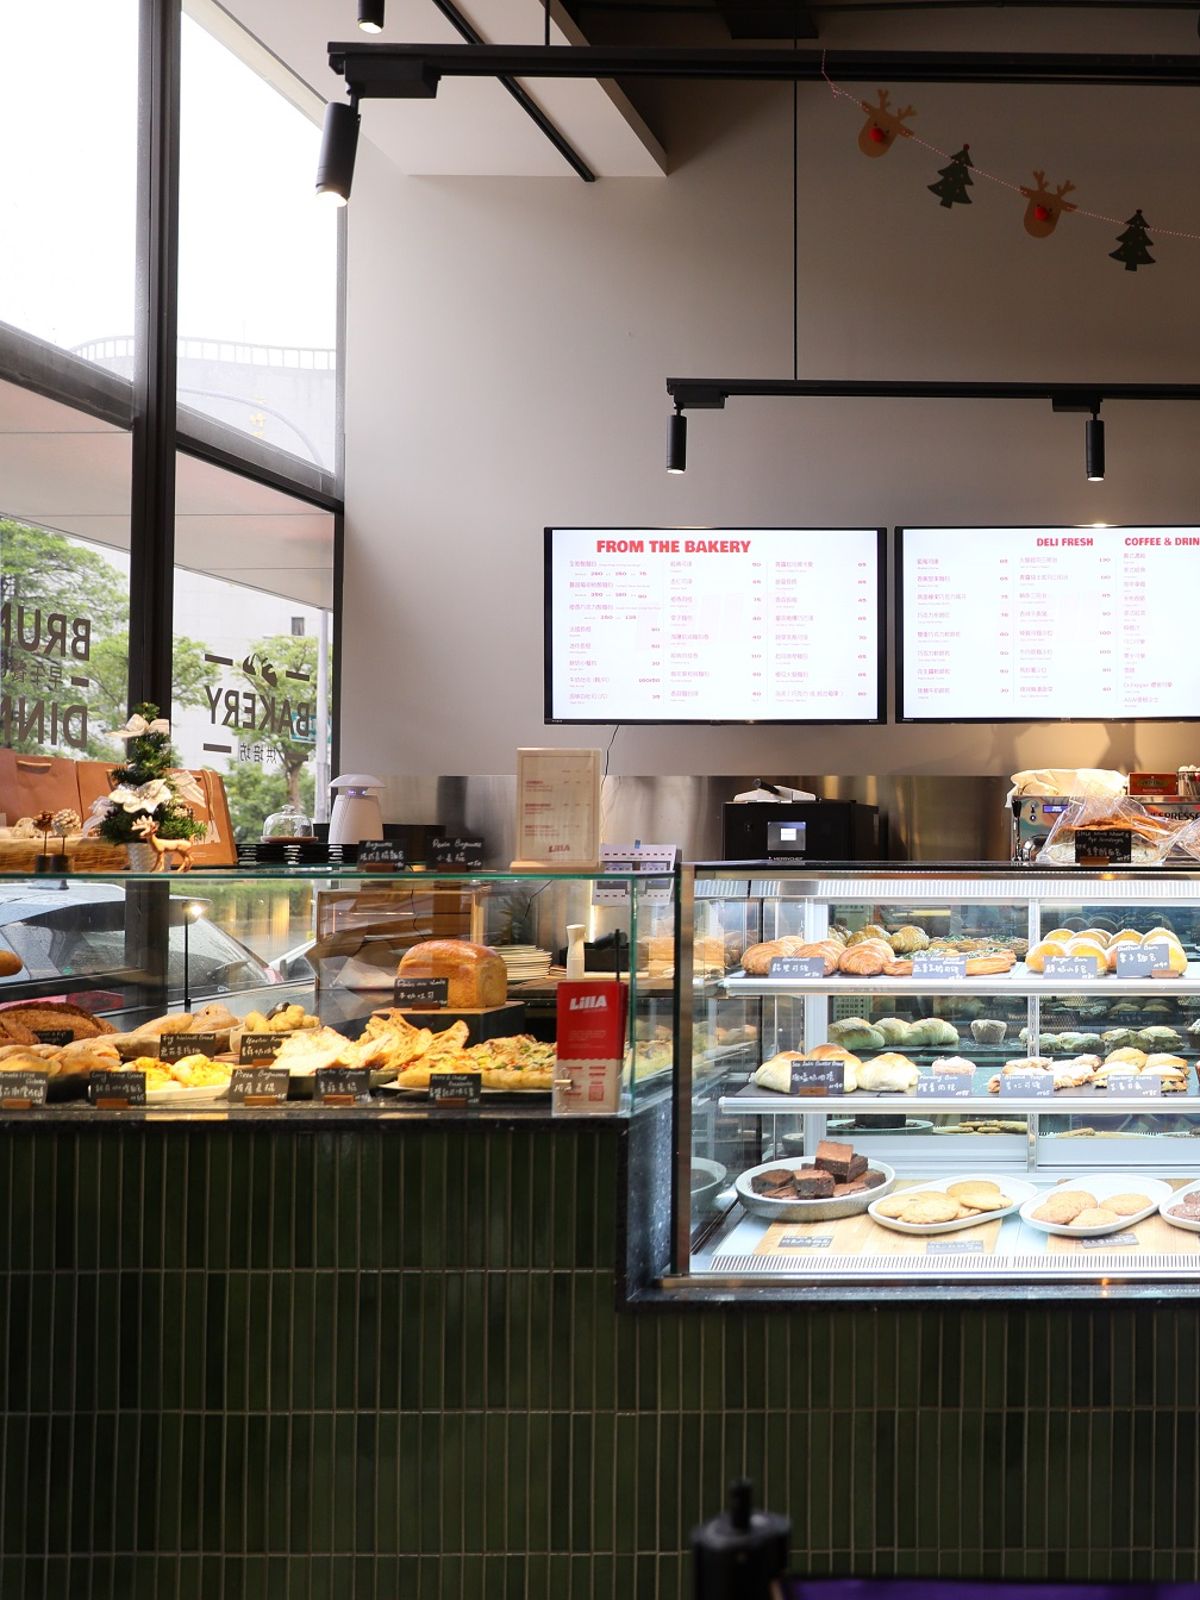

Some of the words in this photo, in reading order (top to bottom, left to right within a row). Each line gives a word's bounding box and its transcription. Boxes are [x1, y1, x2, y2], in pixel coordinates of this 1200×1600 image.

[596, 540, 644, 553] FROM
[649, 540, 680, 553] THE
[685, 540, 751, 553] BAKERY
[1036, 538, 1059, 547] DELI
[1061, 537, 1094, 546] FRESH
[1124, 537, 1161, 546] COFFEE
[1164, 537, 1172, 546] &
